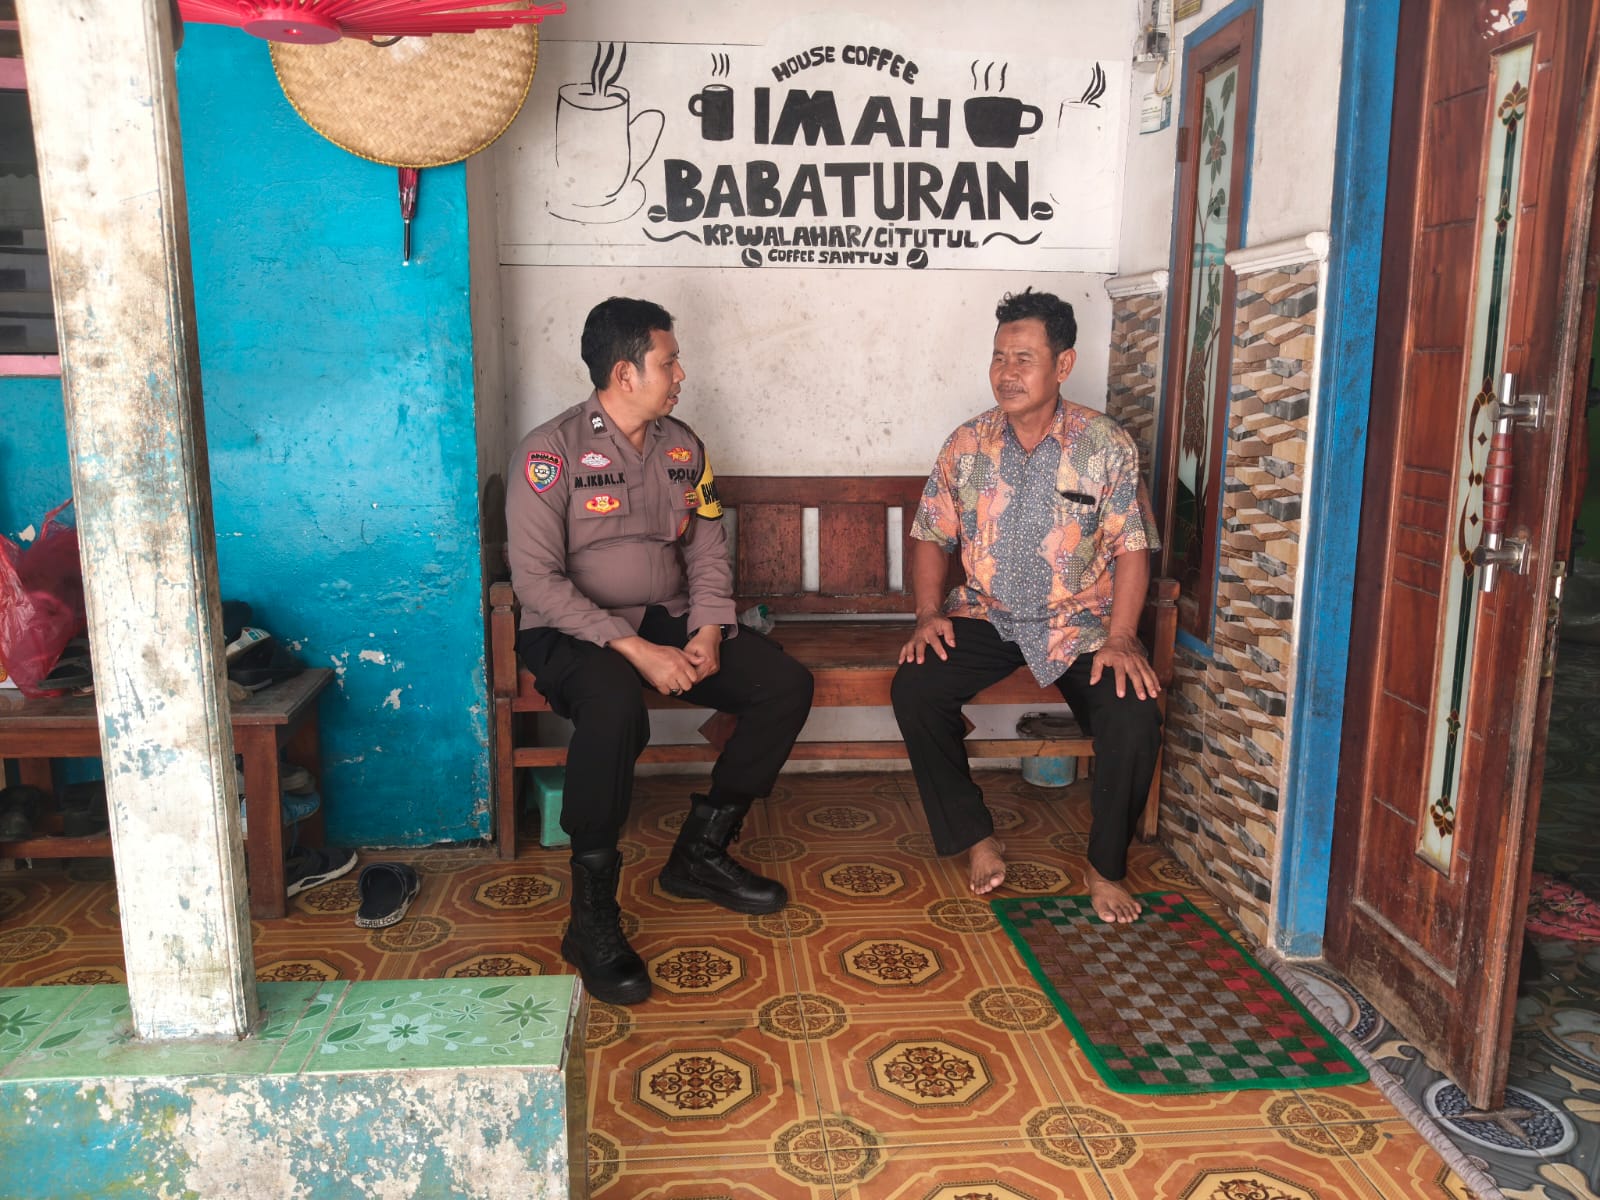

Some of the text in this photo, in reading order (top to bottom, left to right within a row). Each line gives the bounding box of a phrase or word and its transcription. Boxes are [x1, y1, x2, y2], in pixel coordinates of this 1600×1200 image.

[771, 44, 919, 85] HOUSE COFFEE
[754, 87, 951, 149] IMAH
[663, 158, 1030, 222] BABATURAN
[767, 248, 815, 264] COFFEE
